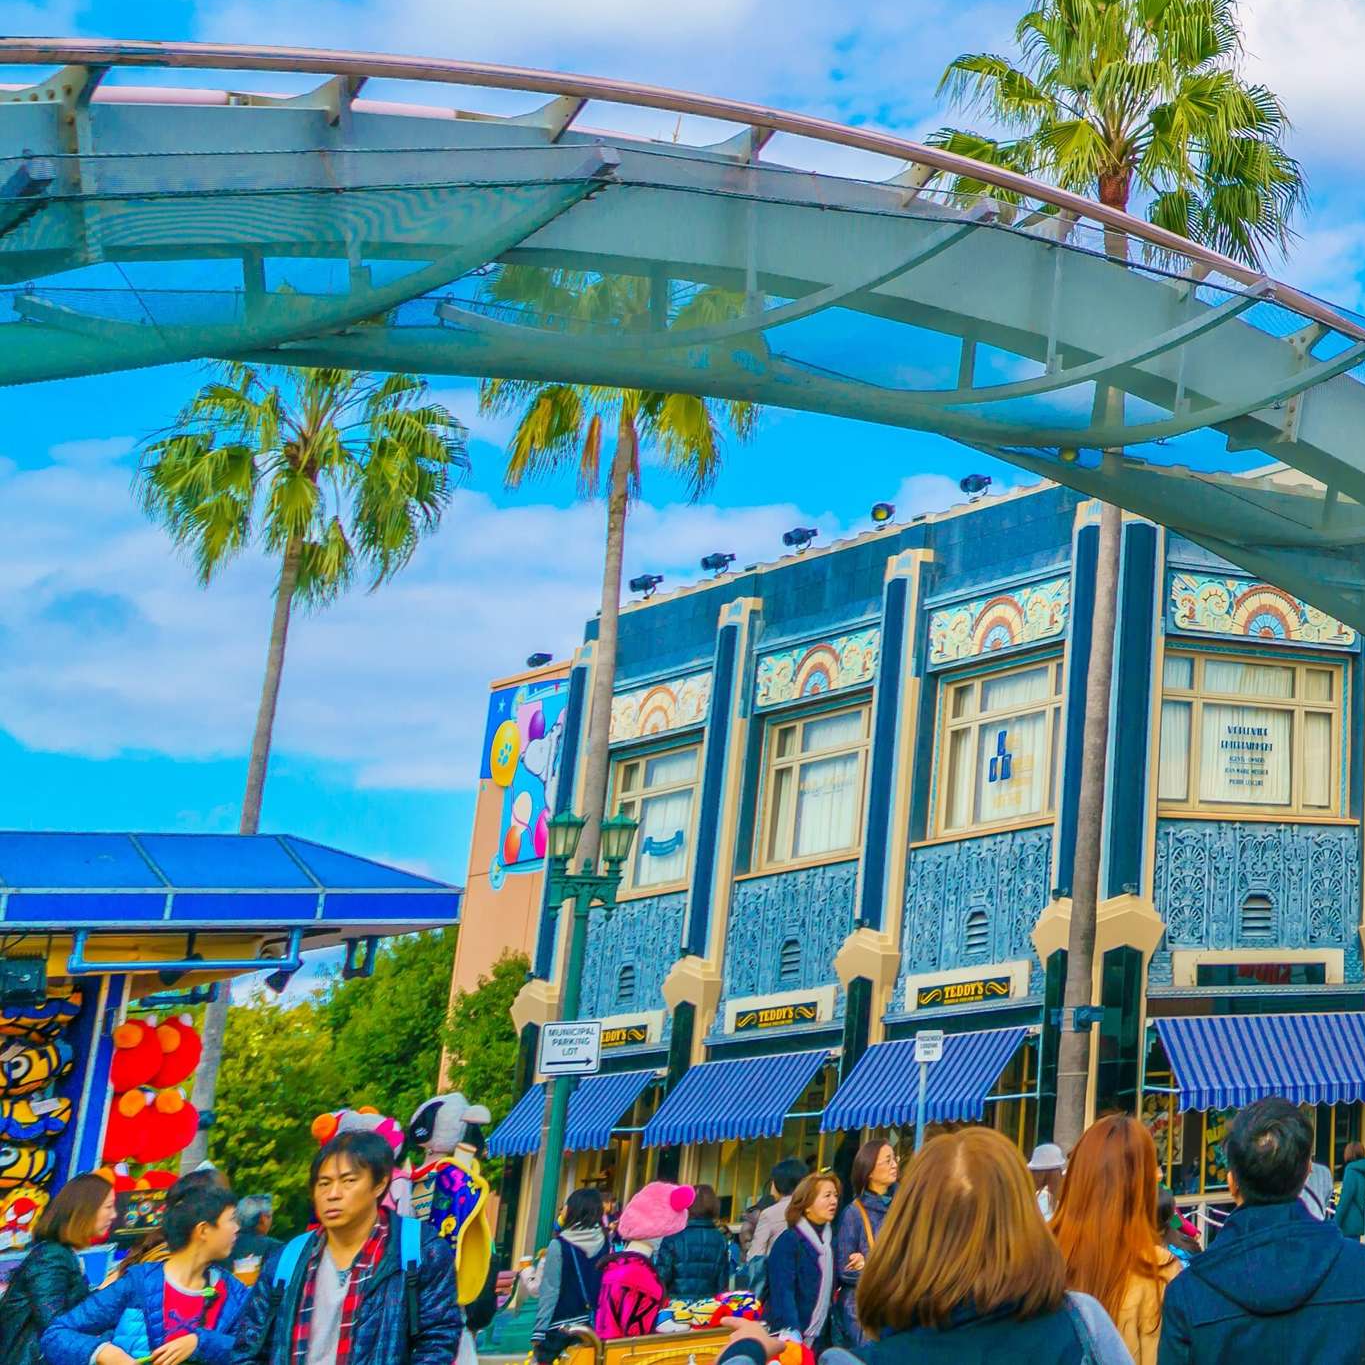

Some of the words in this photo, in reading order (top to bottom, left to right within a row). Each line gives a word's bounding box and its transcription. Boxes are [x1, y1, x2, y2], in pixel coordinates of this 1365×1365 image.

[944, 980, 984, 999] TEDDY'S
[759, 1006, 794, 1023] TEDDY'S
[549, 1027, 595, 1036] MUNICIPAL
[601, 1028, 627, 1044] EDDY'S
[552, 1037, 590, 1047] PARKING
[562, 1046, 578, 1057] LOT
